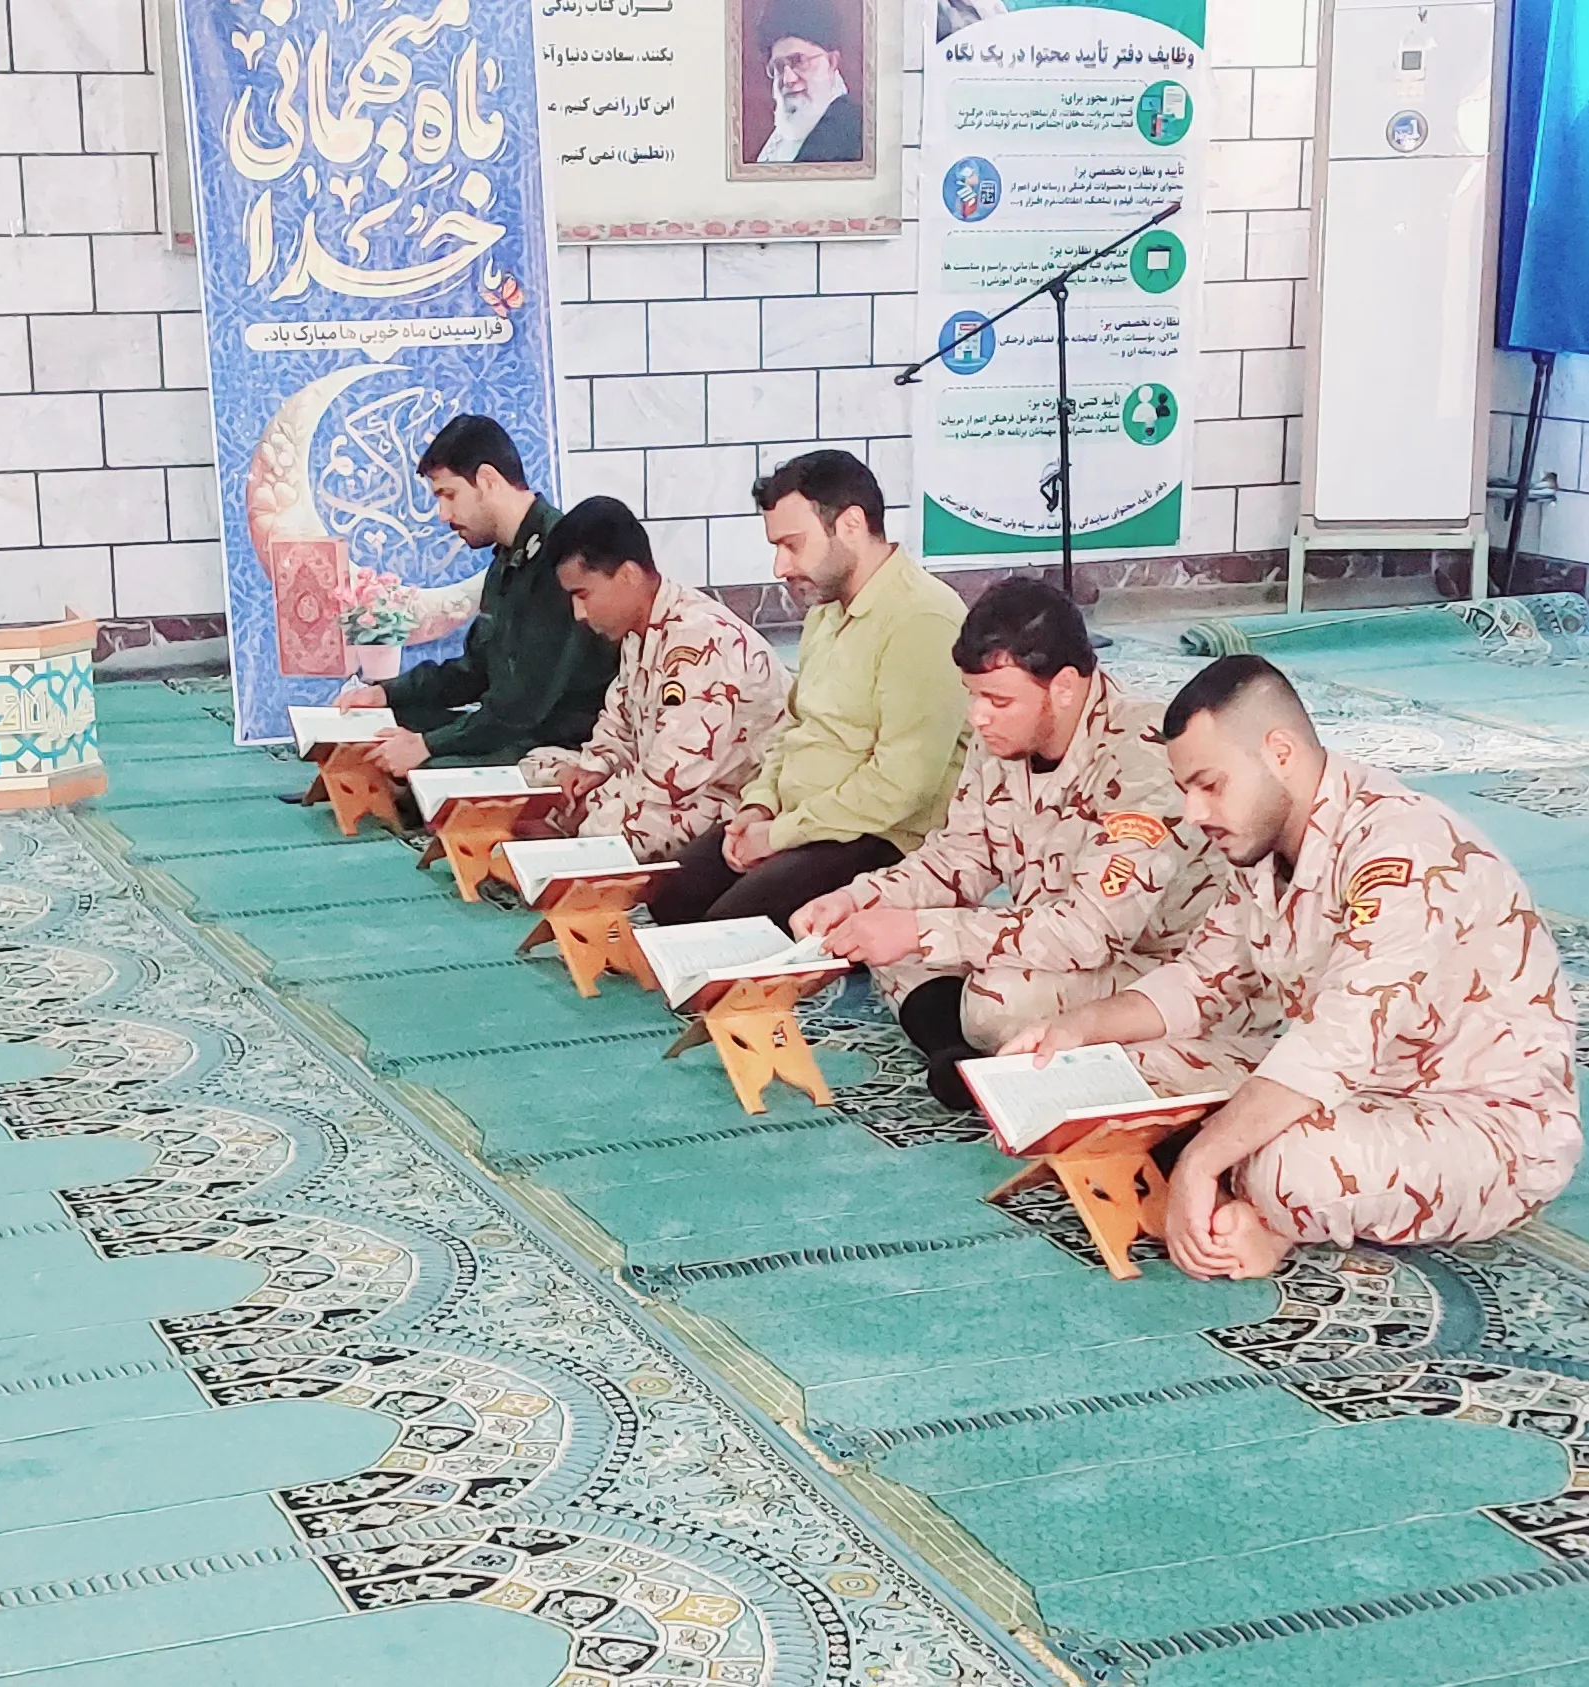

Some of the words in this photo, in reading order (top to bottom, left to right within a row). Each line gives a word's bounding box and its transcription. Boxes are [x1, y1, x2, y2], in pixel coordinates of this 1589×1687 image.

[556, 52, 563, 67] و
[565, 46, 588, 66] دنیا
[592, 47, 634, 62] سعادت
[946, 43, 974, 62] نگاه
[980, 44, 1003, 68] یک
[1008, 48, 1025, 69] در
[1031, 45, 1070, 68] محتوا
[1076, 39, 1109, 69] تأیید
[1113, 44, 1143, 69] دفتر
[1148, 45, 1194, 69] وظایف
[593, 97, 619, 116] نمی
[621, 96, 630, 116] را
[632, 96, 651, 116] کار
[654, 96, 674, 115] این
[589, 146, 615, 165] نمی
[247, 172, 507, 302] خدا
[294, 325, 337, 345] مبارک
[340, 324, 356, 339] ها
[360, 324, 400, 344] خوبی
[402, 324, 426, 339] ماه
